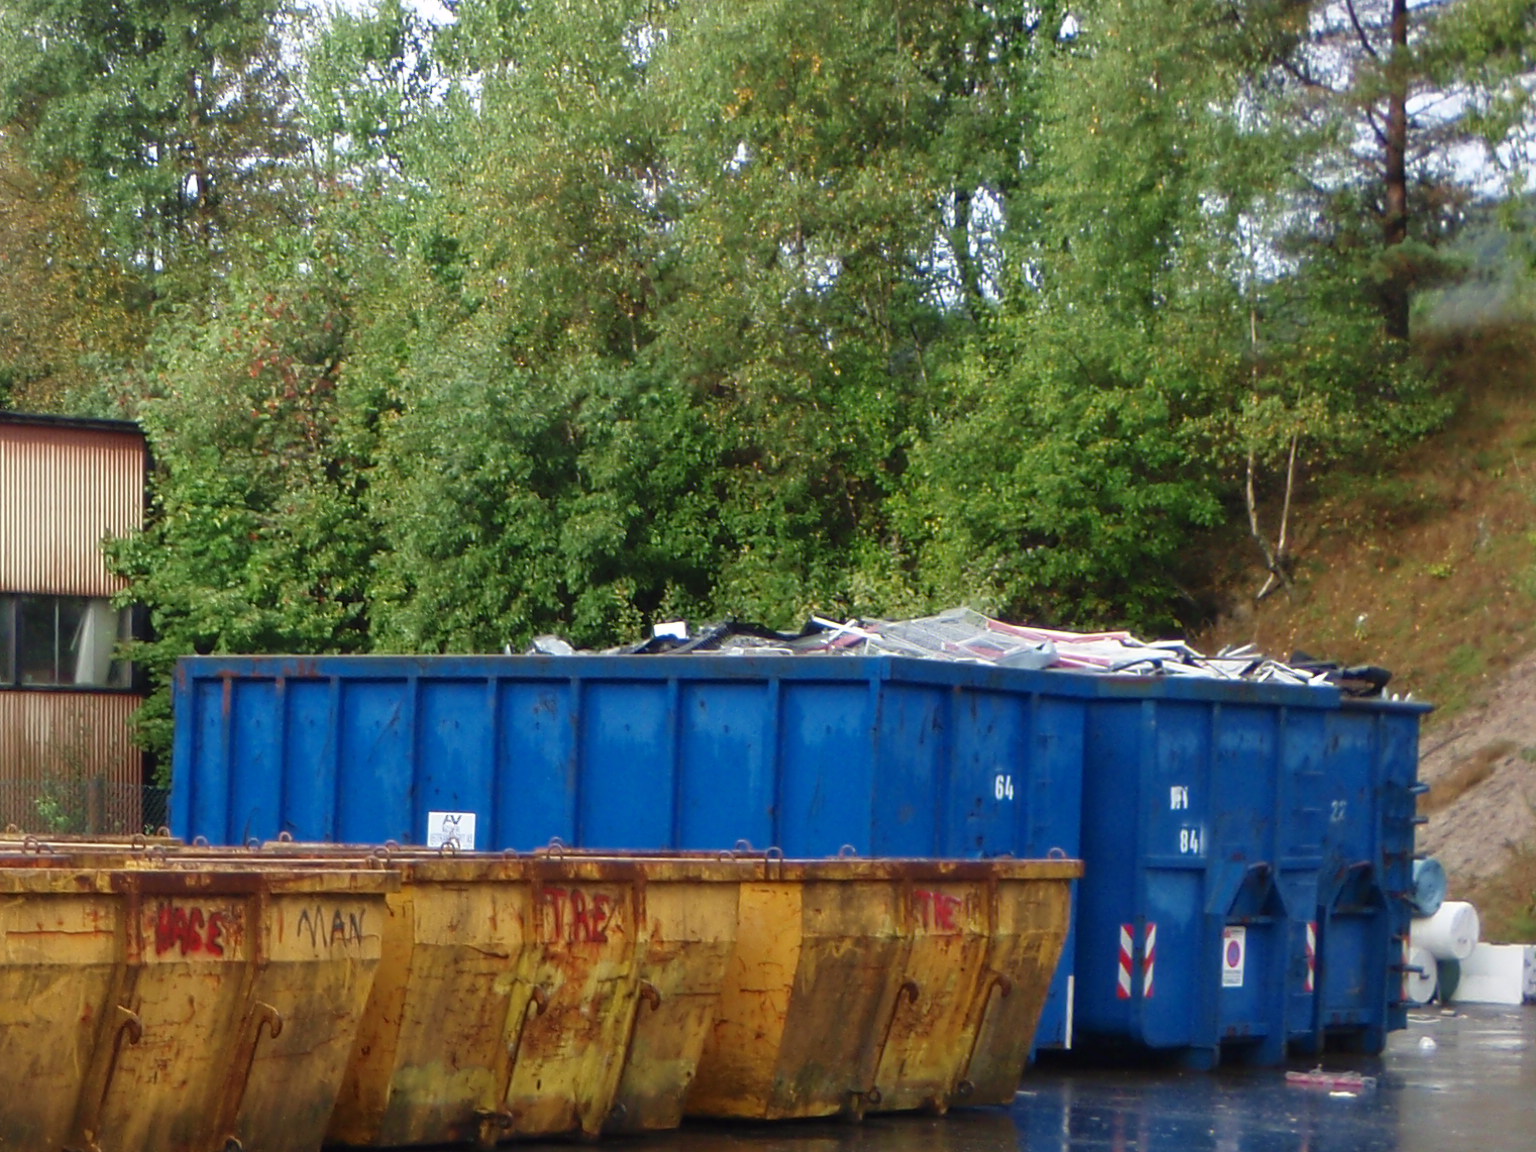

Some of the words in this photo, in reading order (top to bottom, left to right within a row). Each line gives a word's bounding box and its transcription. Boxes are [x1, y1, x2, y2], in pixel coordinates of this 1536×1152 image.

[995, 774, 1014, 800] 64
[1179, 828, 1199, 855] 84
[296, 904, 367, 949] MAN
